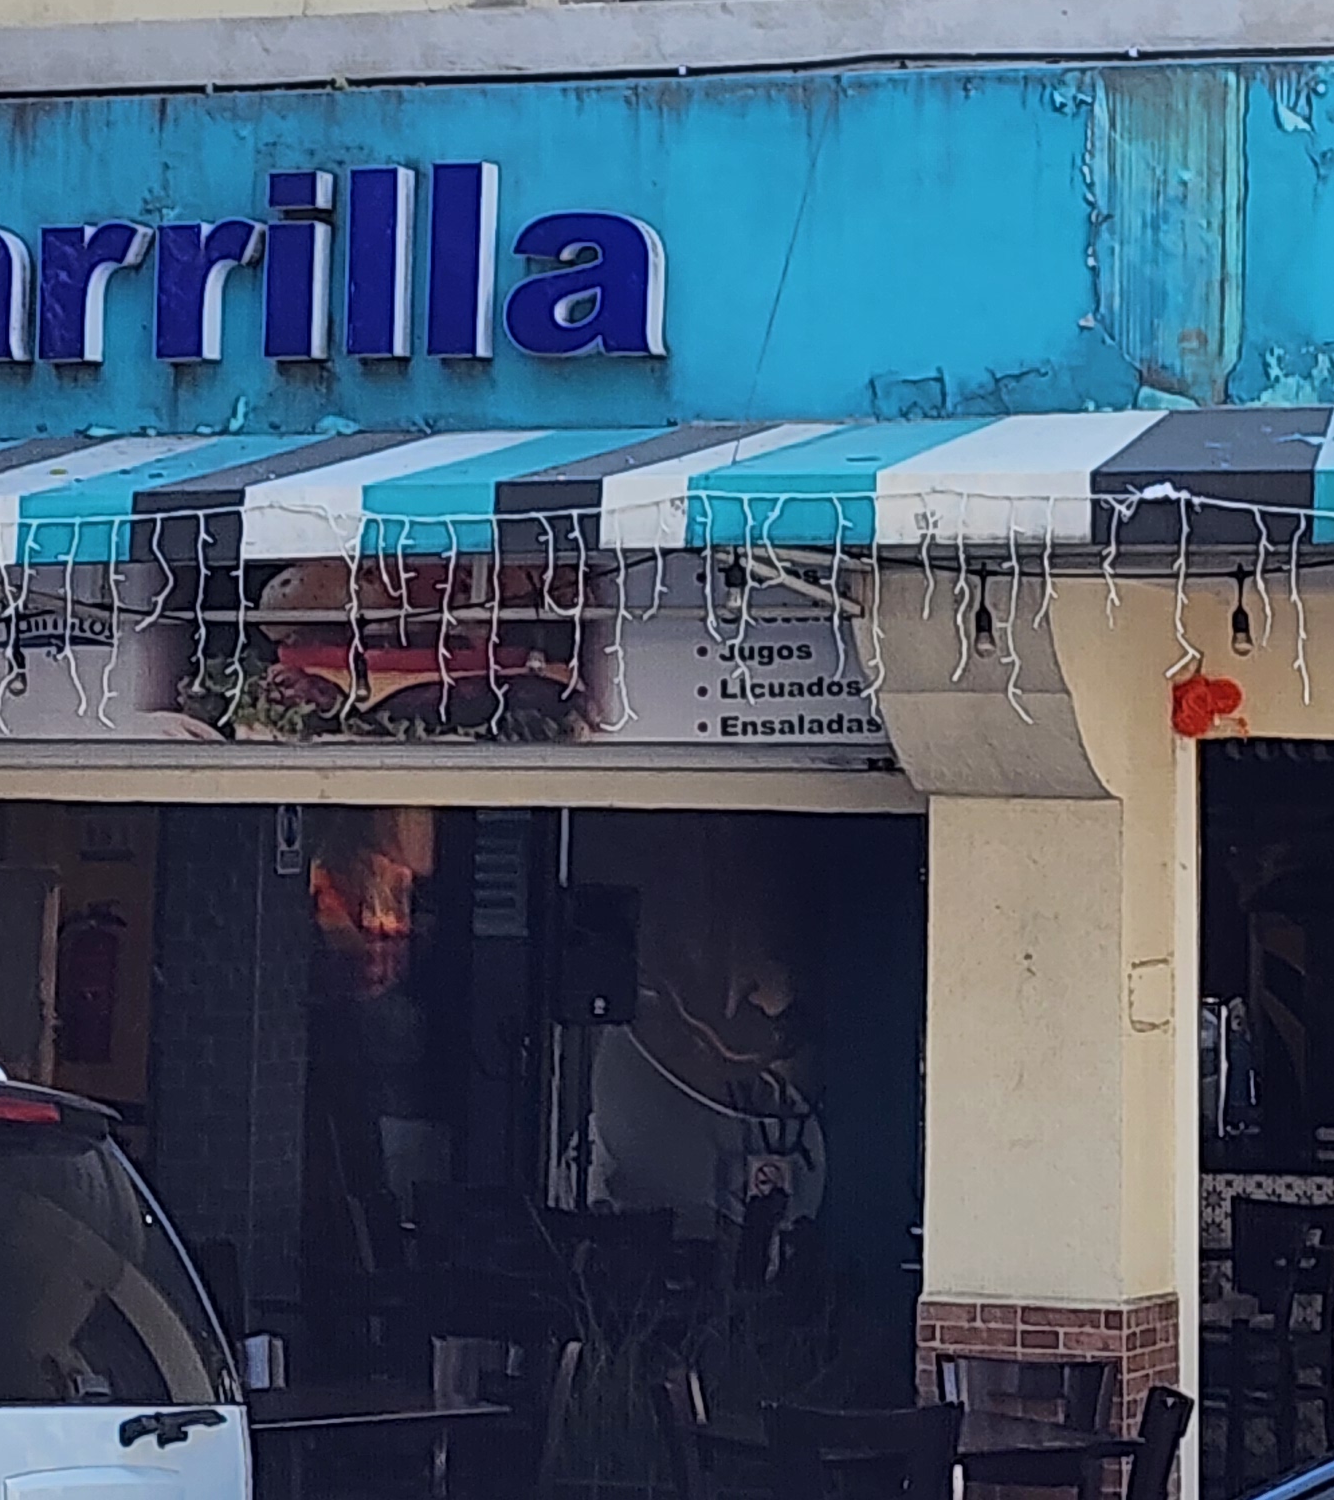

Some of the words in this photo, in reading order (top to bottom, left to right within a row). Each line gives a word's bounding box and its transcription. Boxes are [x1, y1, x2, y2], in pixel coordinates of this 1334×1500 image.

[718, 642, 813, 667] Jugos
[719, 675, 866, 700] Licuados
[719, 712, 883, 737] Ensaladas
